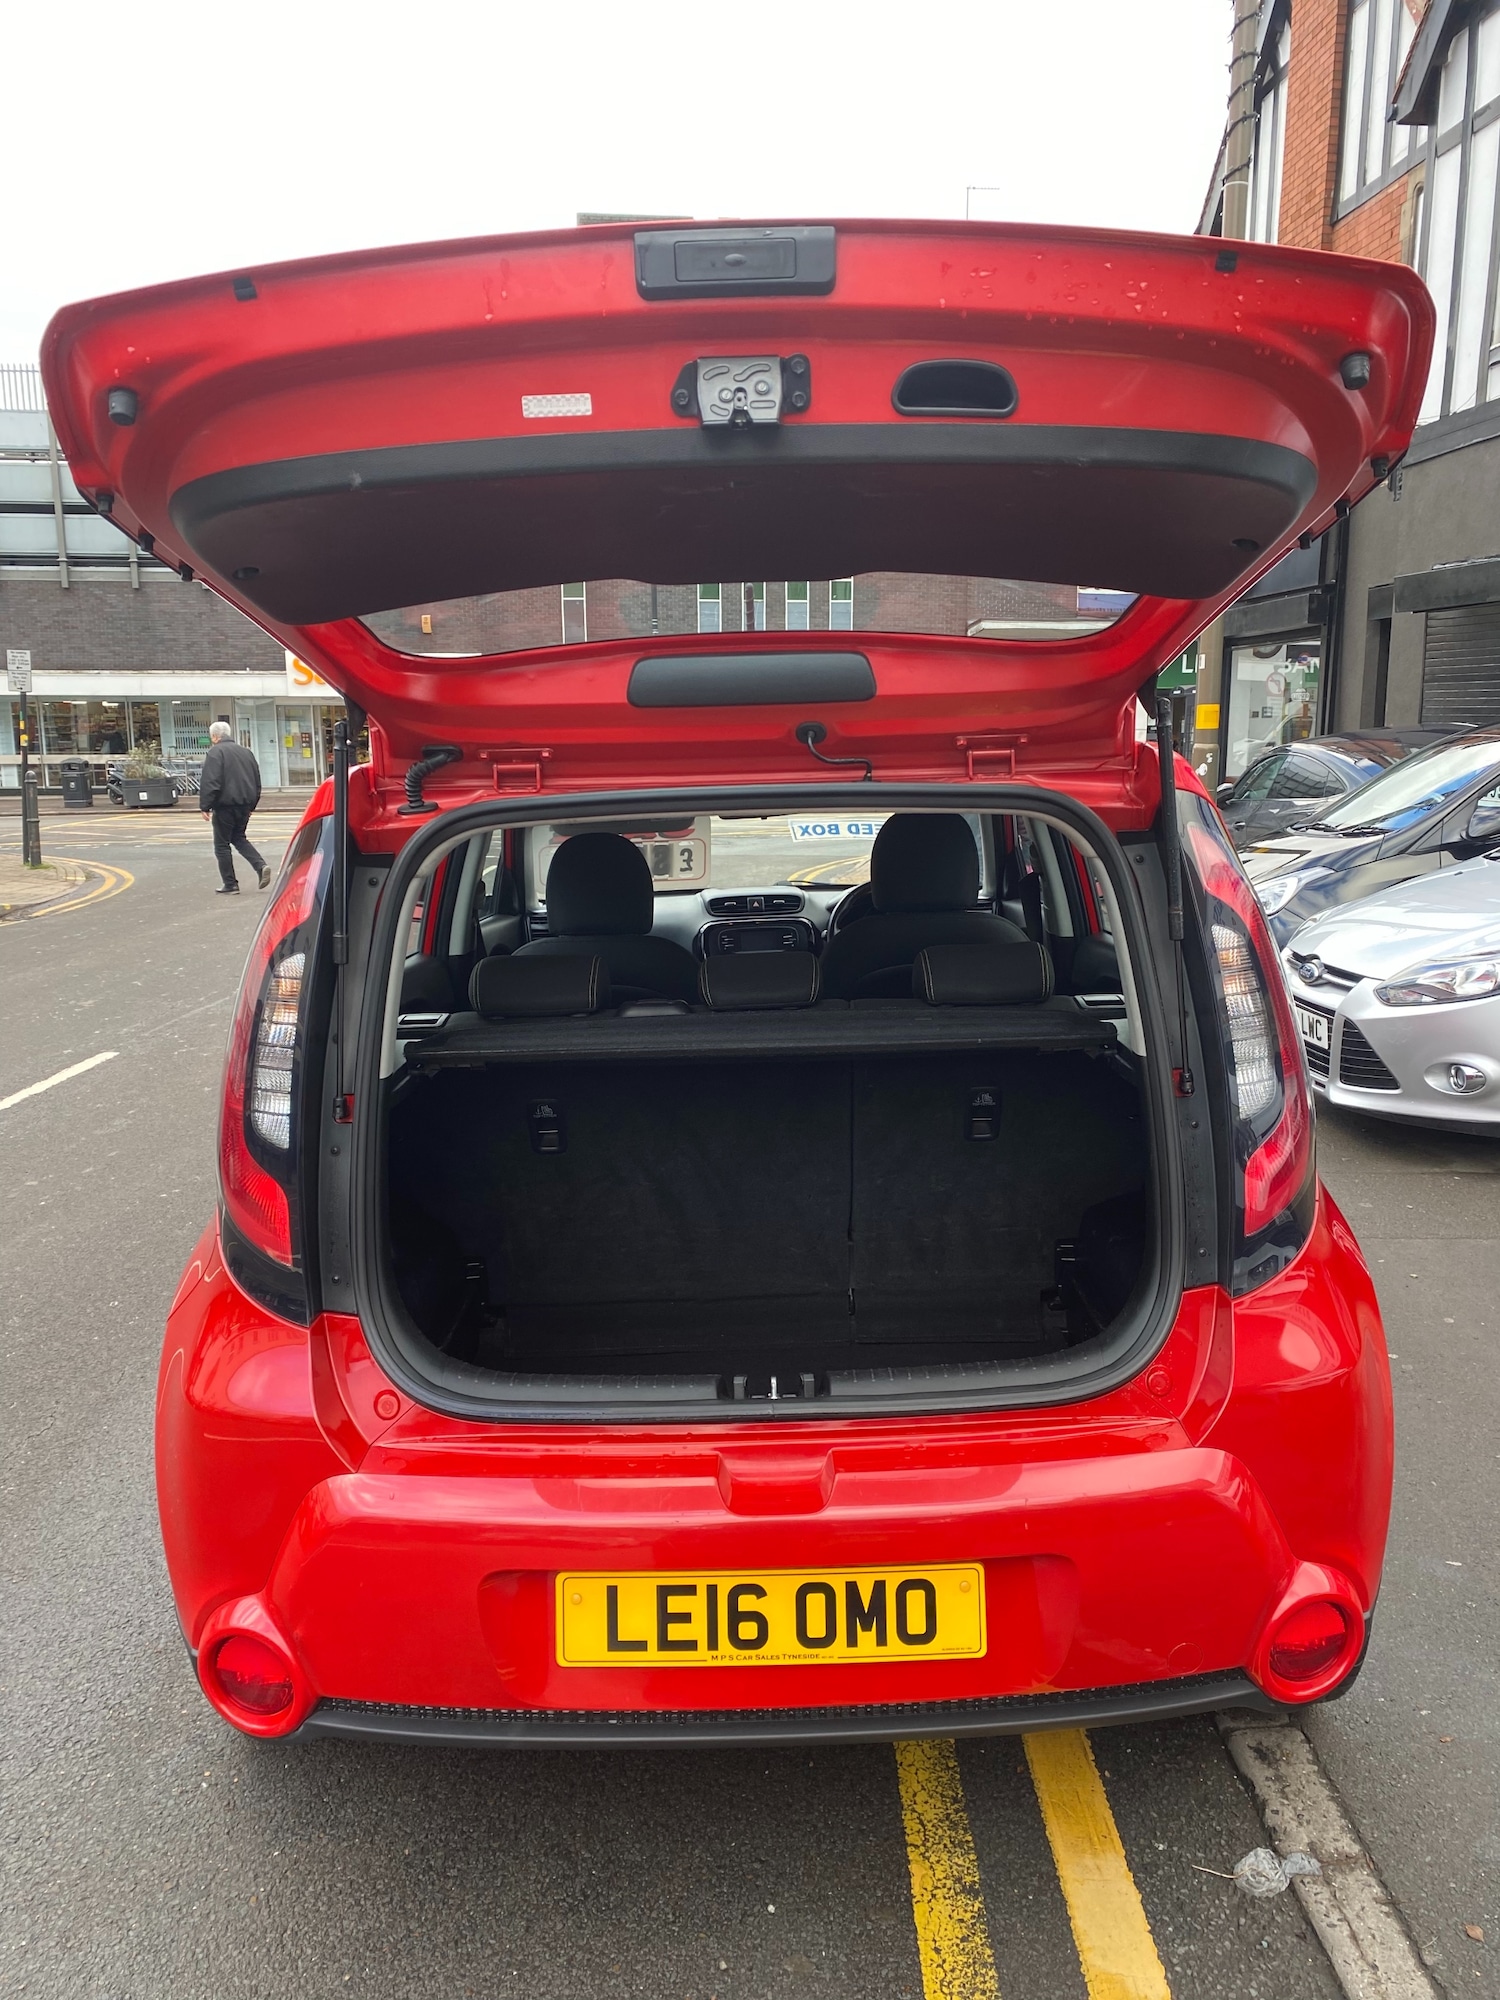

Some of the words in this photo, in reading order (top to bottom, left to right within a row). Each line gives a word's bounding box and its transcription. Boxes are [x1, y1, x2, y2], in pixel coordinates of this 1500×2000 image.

[1301, 1012, 1322, 1042] LWC
[606, 1583, 769, 1652] LE16
[795, 1578, 936, 1649] OMO
